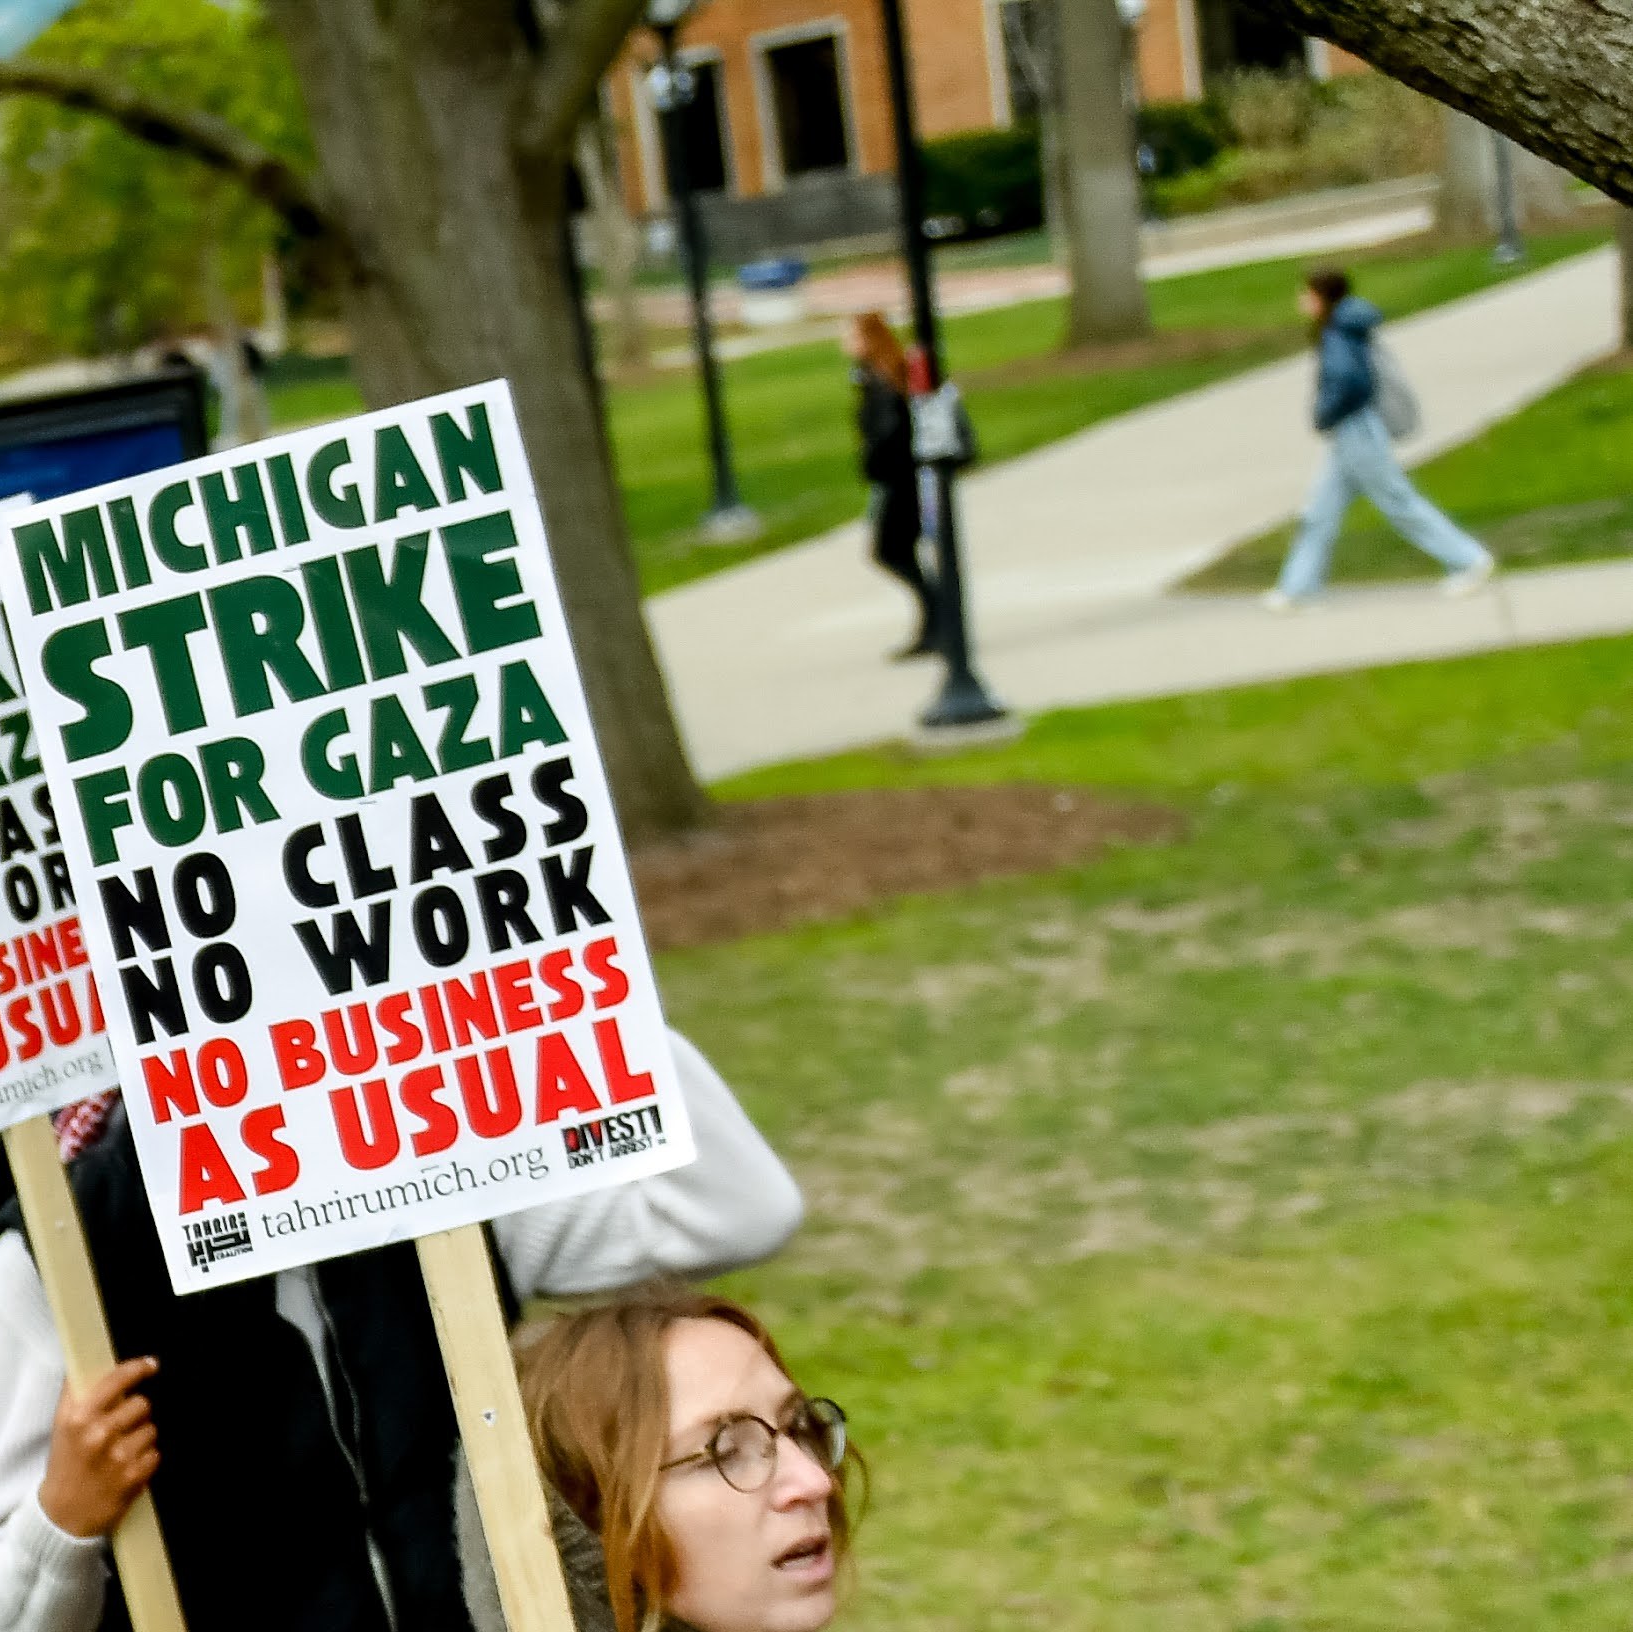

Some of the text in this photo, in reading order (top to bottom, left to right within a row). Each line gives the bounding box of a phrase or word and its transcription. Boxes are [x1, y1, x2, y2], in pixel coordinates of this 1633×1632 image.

[12, 402, 503, 616] MICHIGAN
[41, 510, 542, 763] STRIKE
[72, 659, 569, 867] FOR GAZA
[97, 757, 588, 960] NO CLASS
[120, 845, 614, 1045] NO WORK
[140, 936, 630, 1125] NO BUSINESS
[179, 1017, 656, 1216] AS USUAL
[262, 1146, 545, 1240] tahrirumich.org
